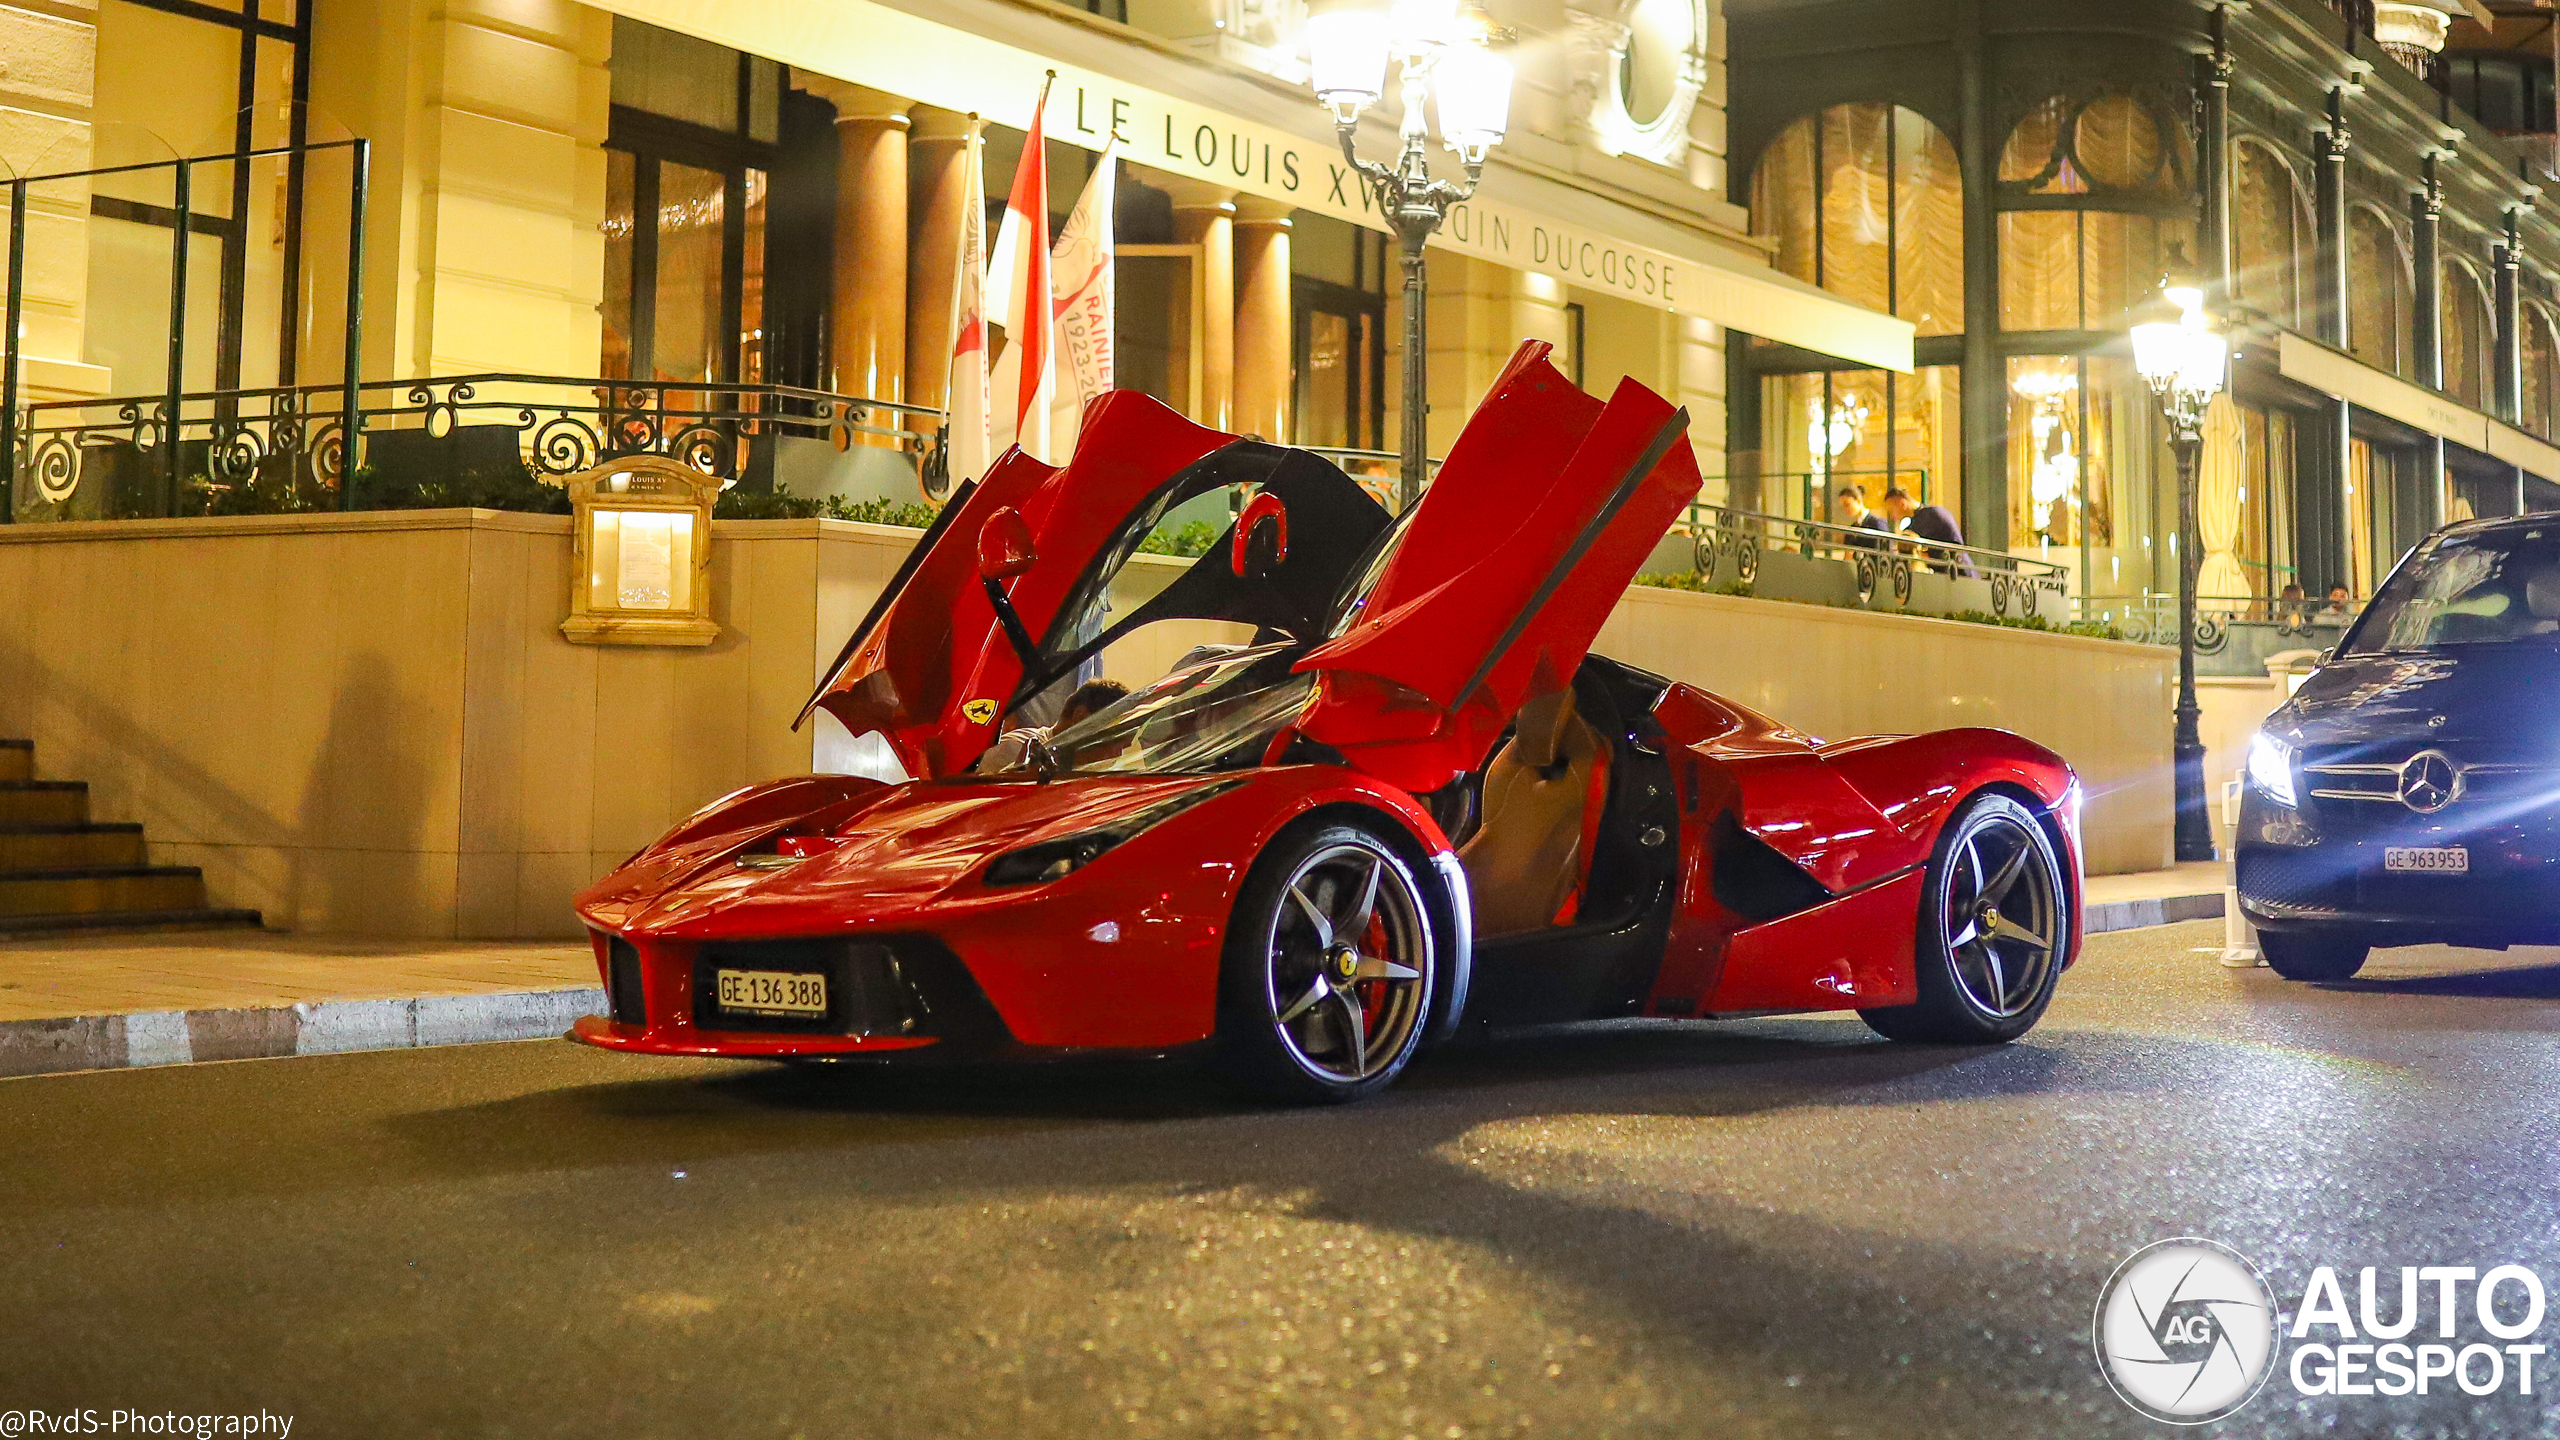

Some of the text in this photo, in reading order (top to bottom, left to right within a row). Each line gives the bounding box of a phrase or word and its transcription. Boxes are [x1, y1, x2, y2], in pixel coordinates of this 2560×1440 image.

[1077, 87, 1130, 144] LE
[1166, 114, 1299, 191] LOUIS
[1328, 163, 1377, 214] XV
[1534, 227, 1675, 301] DUCASSE
